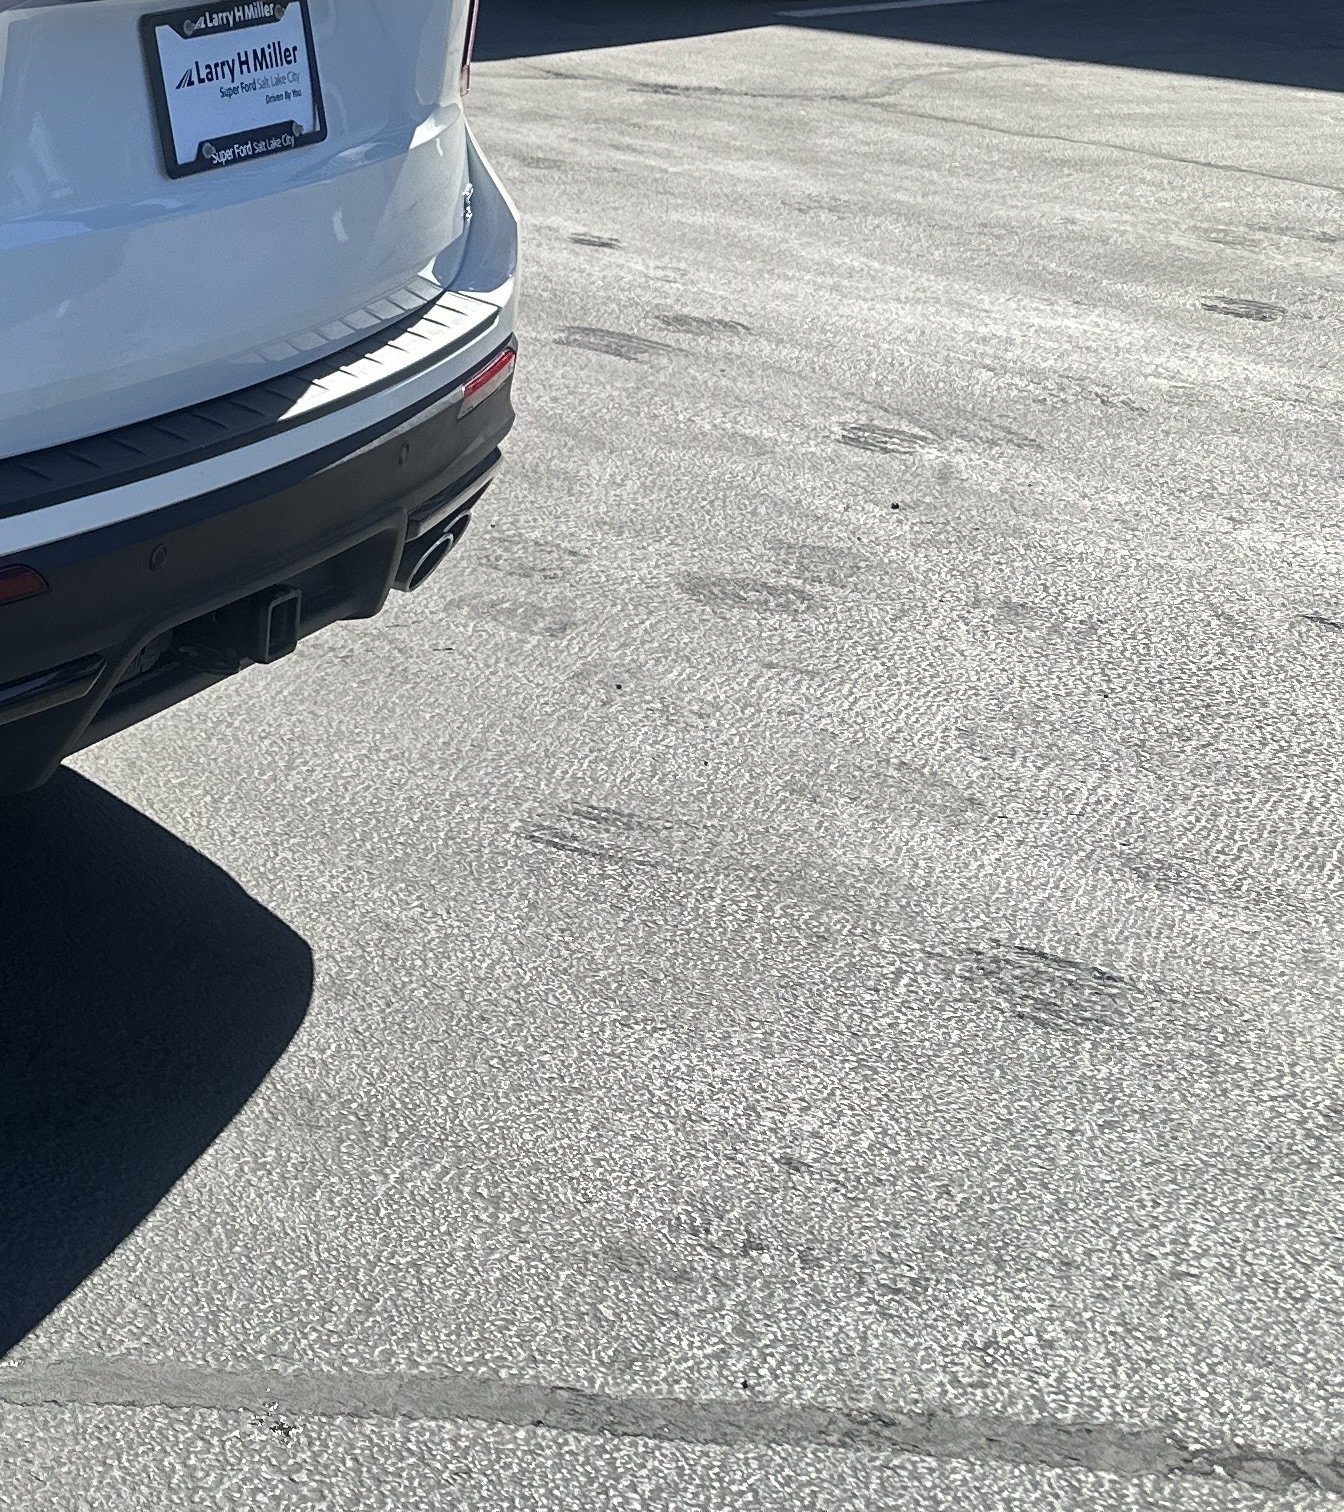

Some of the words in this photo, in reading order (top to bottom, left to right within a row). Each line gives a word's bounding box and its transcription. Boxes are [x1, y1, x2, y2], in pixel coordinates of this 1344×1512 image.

[205, 11, 234, 28] Larry
[234, 5, 244, 22] H
[244, 1, 274, 20] Miller
[195, 58, 235, 84] Larry
[237, 50, 251, 75] H
[252, 40, 298, 72] Miller
[219, 84, 240, 99] Super
[240, 77, 257, 93] Ford
[257, 76, 271, 90] Salt
[270, 72, 286, 87] Lake
[286, 70, 301, 84] City
[211, 148, 233, 165] Super
[233, 140, 253, 158] Ford
[253, 140, 267, 154] Salt
[266, 137, 282, 151] Lake
[281, 133, 295, 148] City
